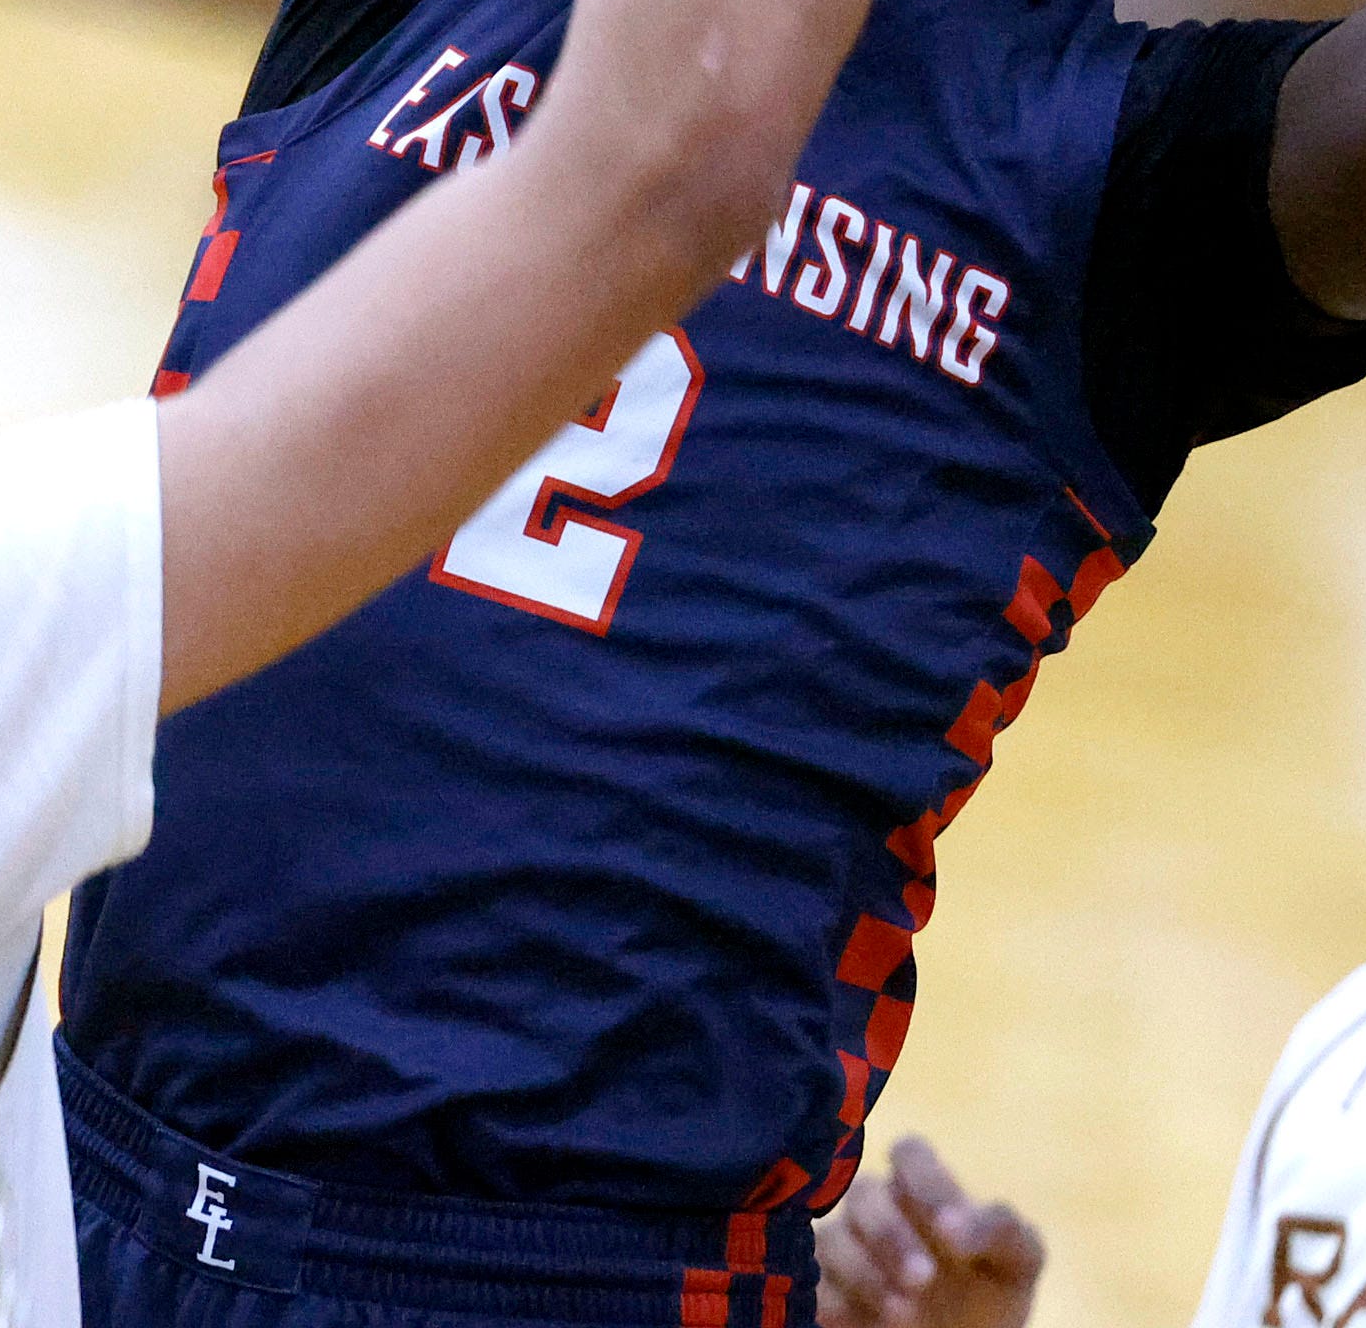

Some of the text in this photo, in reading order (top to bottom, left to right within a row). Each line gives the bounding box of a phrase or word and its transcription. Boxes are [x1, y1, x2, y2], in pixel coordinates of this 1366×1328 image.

[367, 44, 1011, 387] EAS NSING
[429, 327, 705, 636] 2
